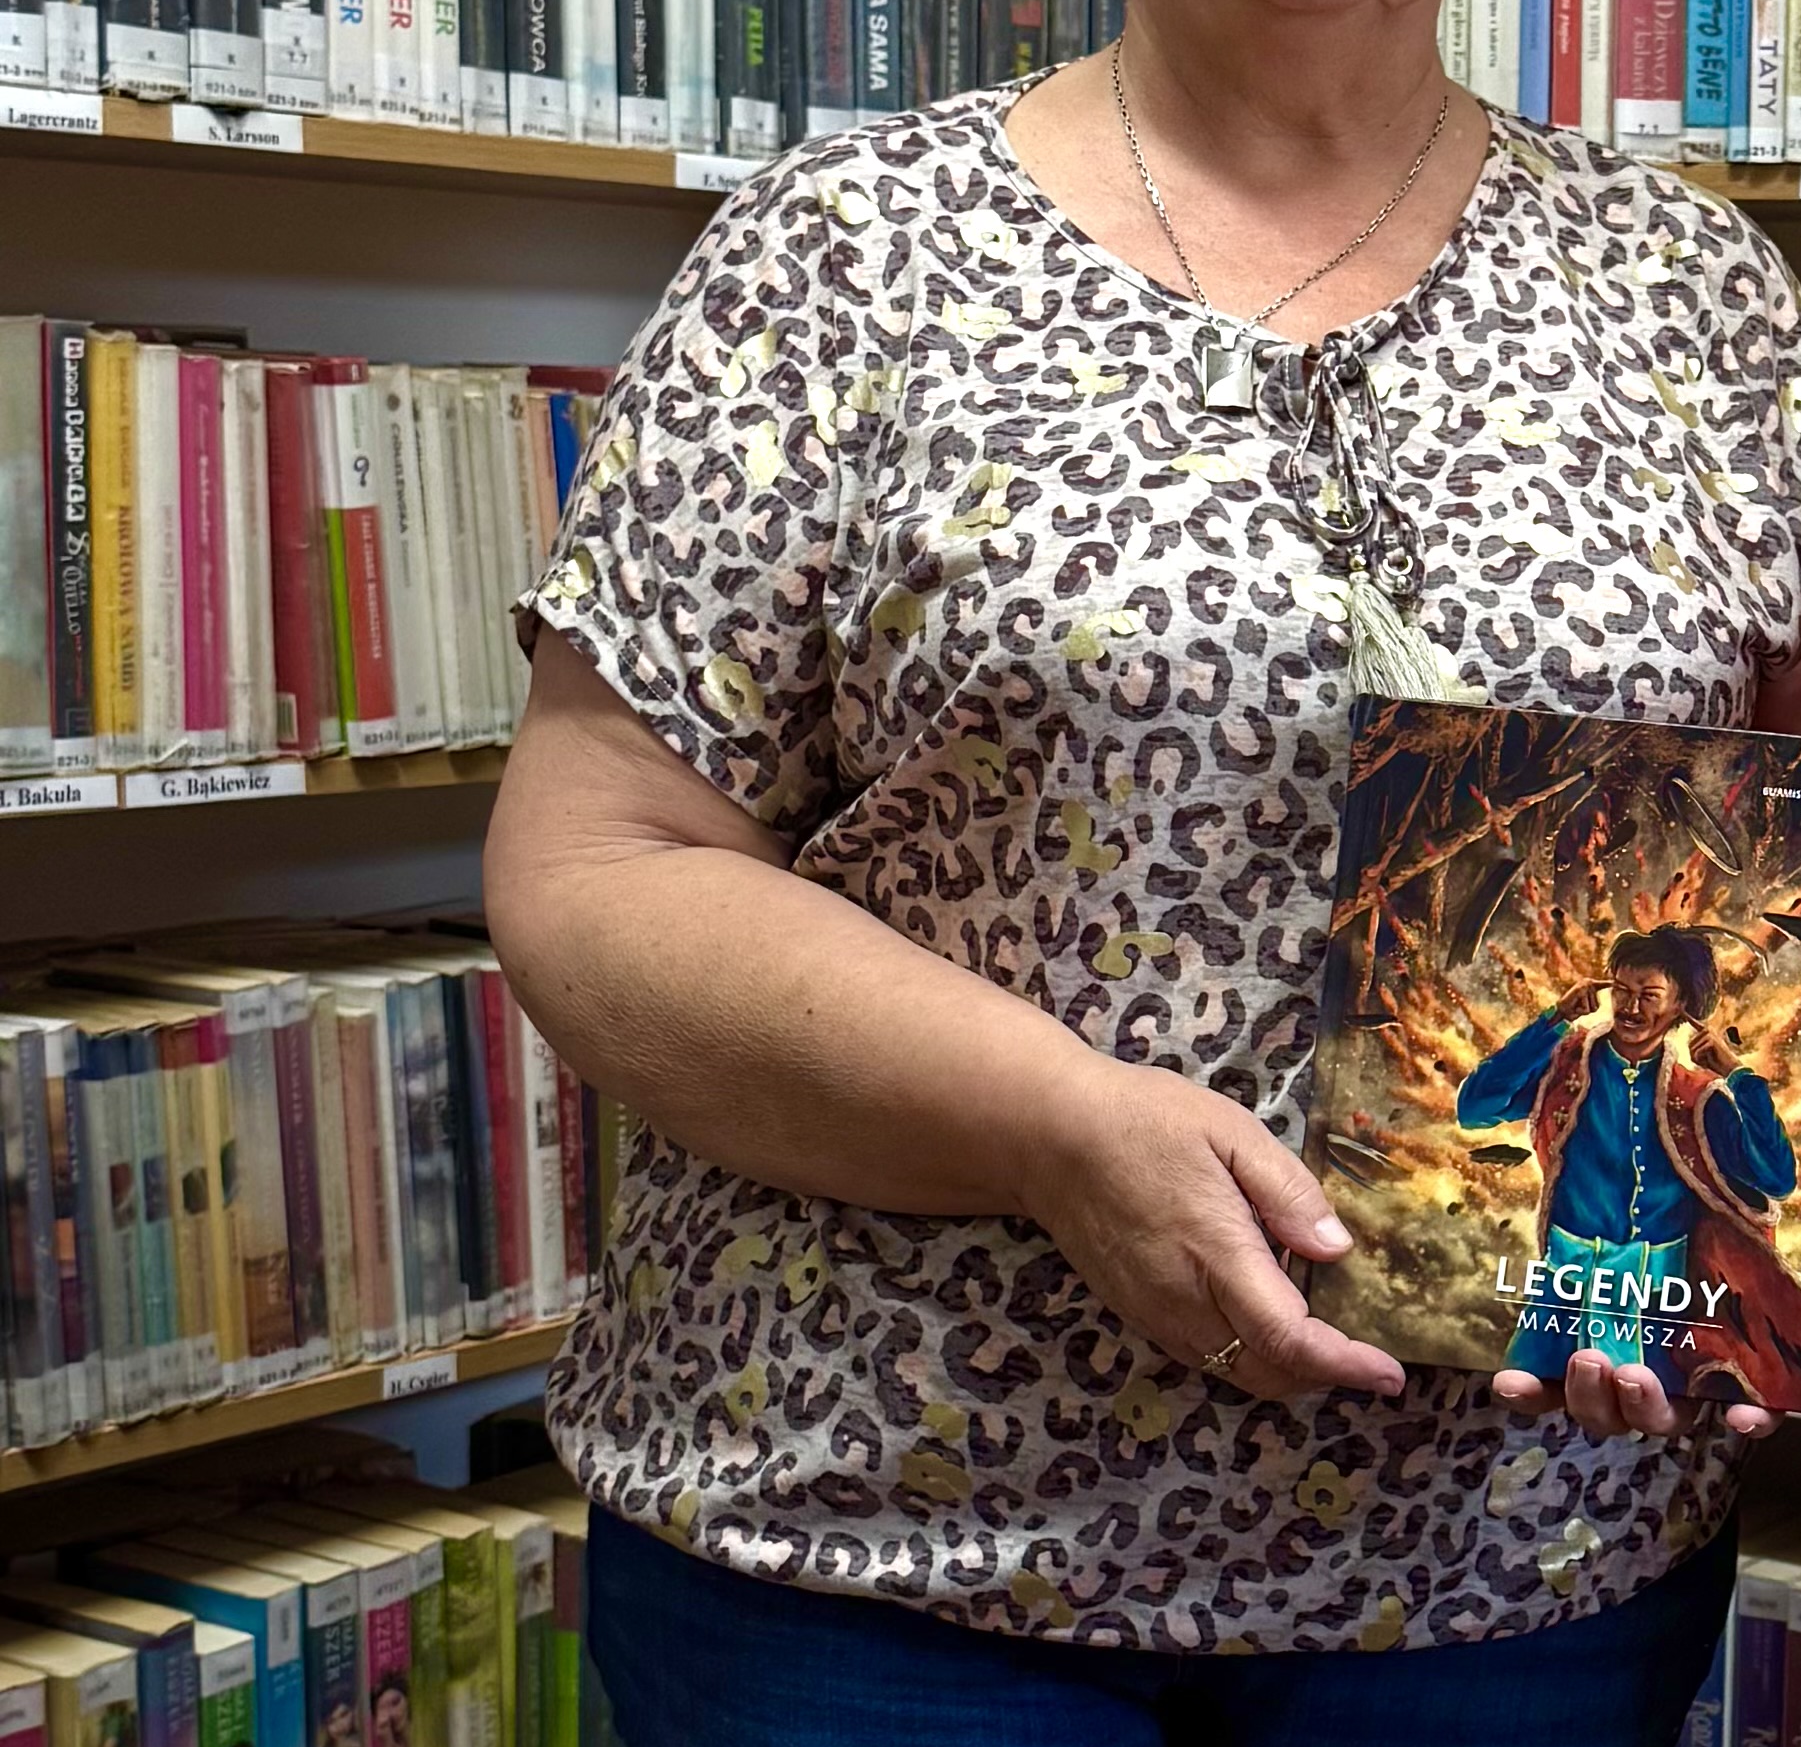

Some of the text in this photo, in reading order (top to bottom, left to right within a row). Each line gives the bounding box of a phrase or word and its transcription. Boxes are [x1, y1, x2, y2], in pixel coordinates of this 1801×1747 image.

[868, 14, 891, 92] SAMA
[1757, 38, 1778, 118] TATY
[8, 106, 100, 132] Lagercrantz
[228, 126, 281, 148] Larsson
[160, 776, 181, 798] G.
[1495, 1256, 1730, 1319] LEGENDY
[1515, 1308, 1699, 1352] MAZOWSZA
